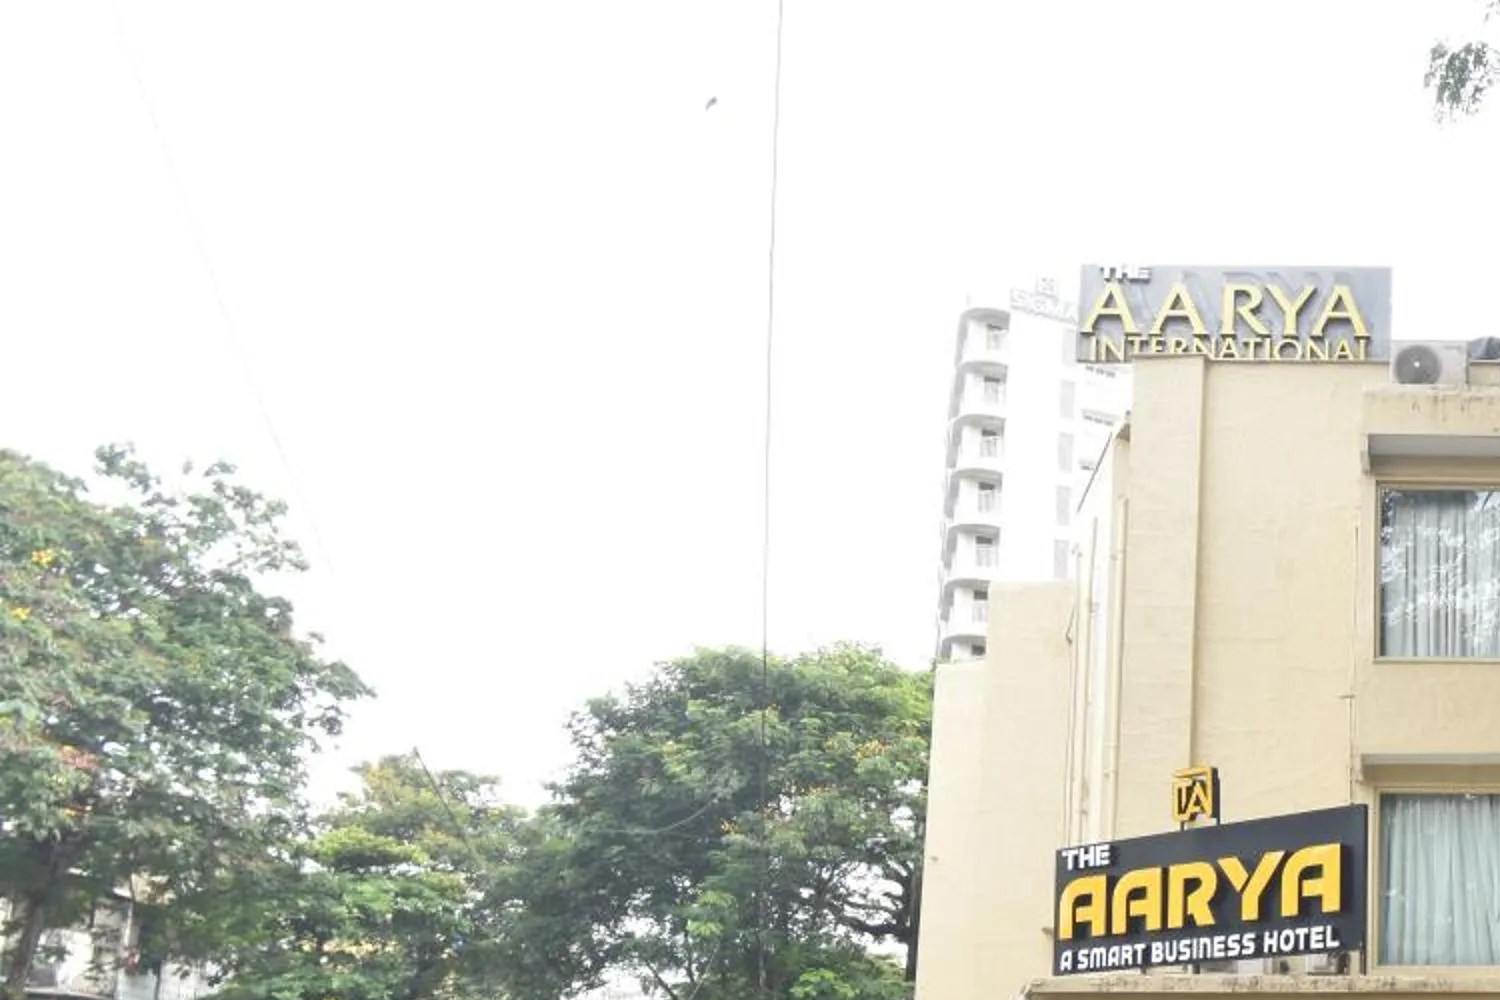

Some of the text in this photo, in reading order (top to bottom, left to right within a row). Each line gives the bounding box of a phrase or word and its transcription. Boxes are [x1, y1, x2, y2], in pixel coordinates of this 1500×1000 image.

[1080, 281, 1371, 336] AARYA
[1061, 843, 1111, 871] THE
[1059, 842, 1341, 940] AARYA
[1059, 924, 1340, 971] A SMART BUSINESS HOTEL
